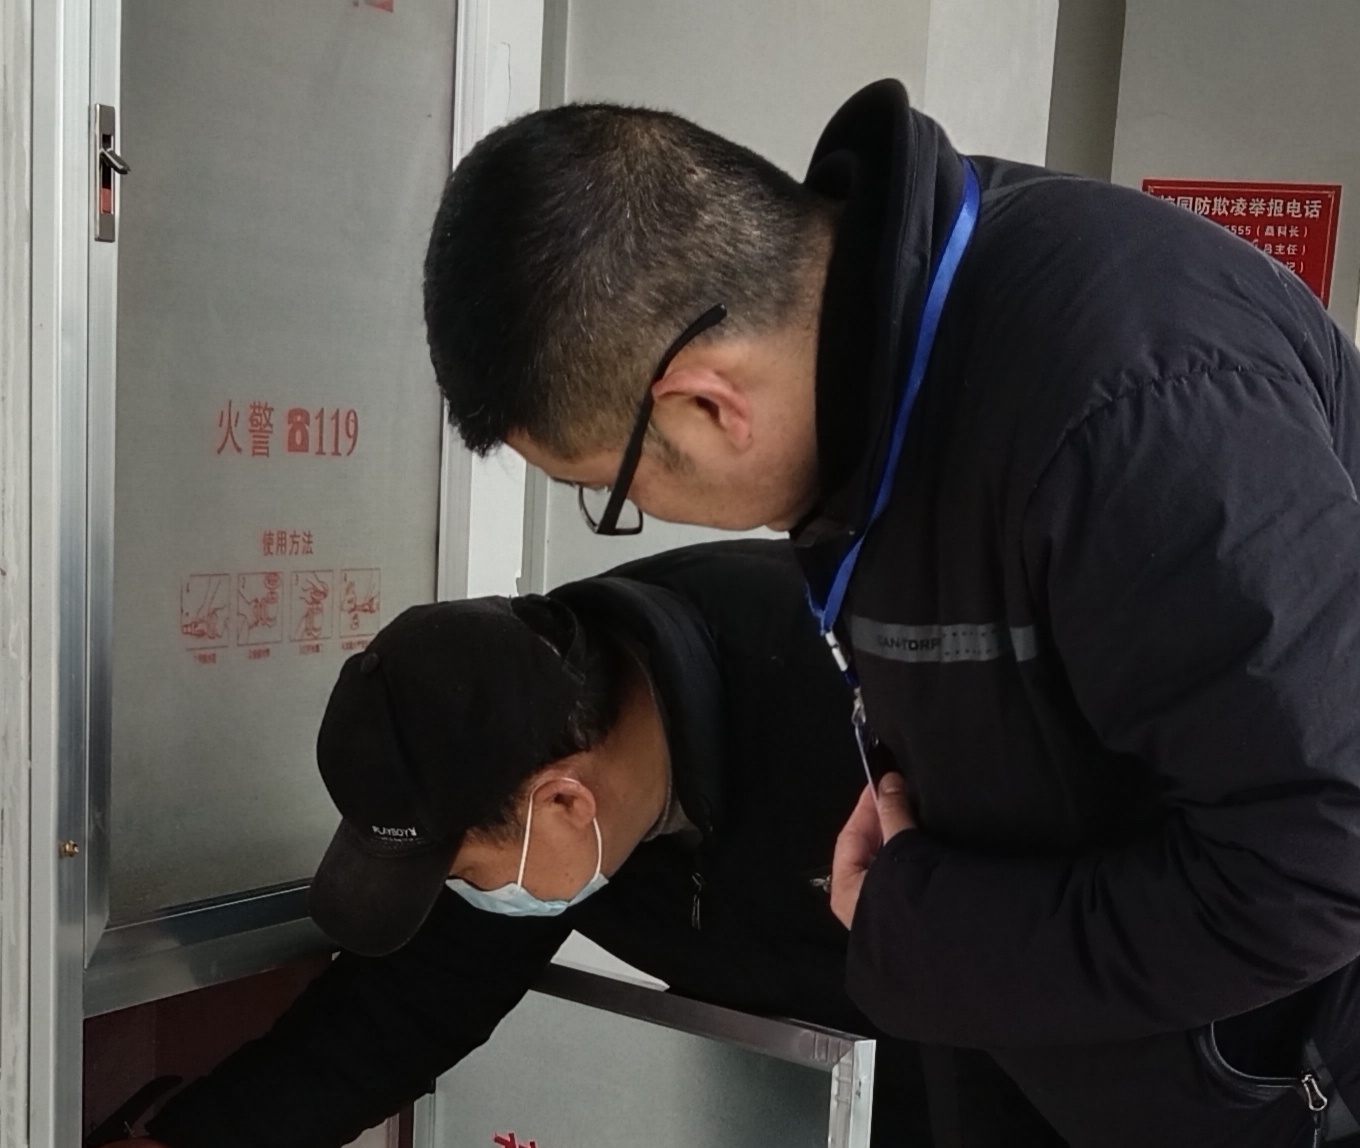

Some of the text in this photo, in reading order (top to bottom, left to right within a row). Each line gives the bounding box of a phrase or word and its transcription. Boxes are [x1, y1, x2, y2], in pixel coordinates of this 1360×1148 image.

[216, 399, 359, 458] 火警 119
[263, 530, 314, 556] 使用方法
